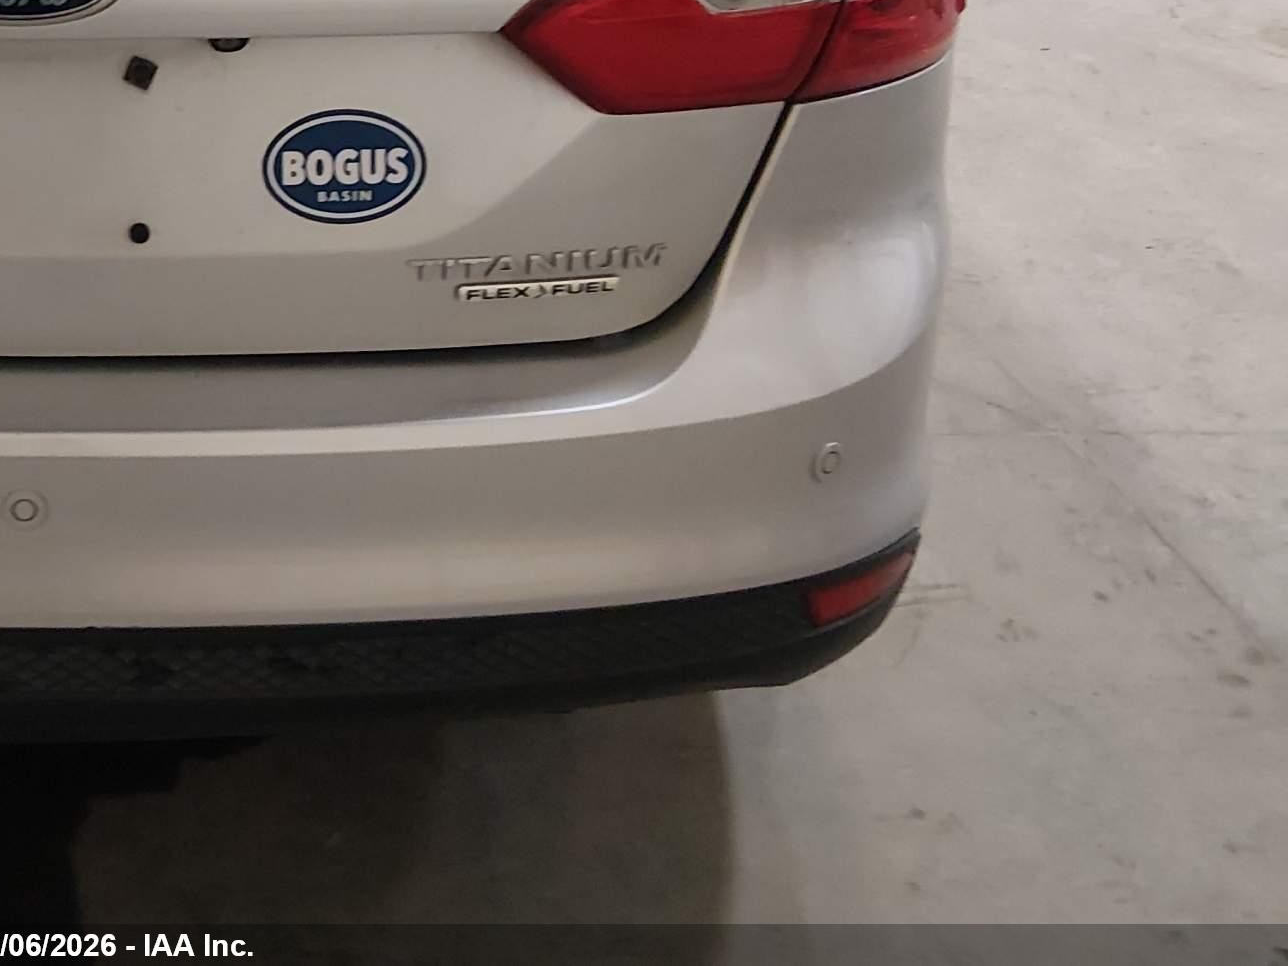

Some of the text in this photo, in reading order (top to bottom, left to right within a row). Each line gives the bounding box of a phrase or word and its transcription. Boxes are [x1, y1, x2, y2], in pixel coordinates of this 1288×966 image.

[281, 147, 409, 185] BOGUS
[317, 190, 373, 202] BASIN
[405, 242, 667, 281] TITANIUM
[466, 281, 615, 301] FLEX FUEL
